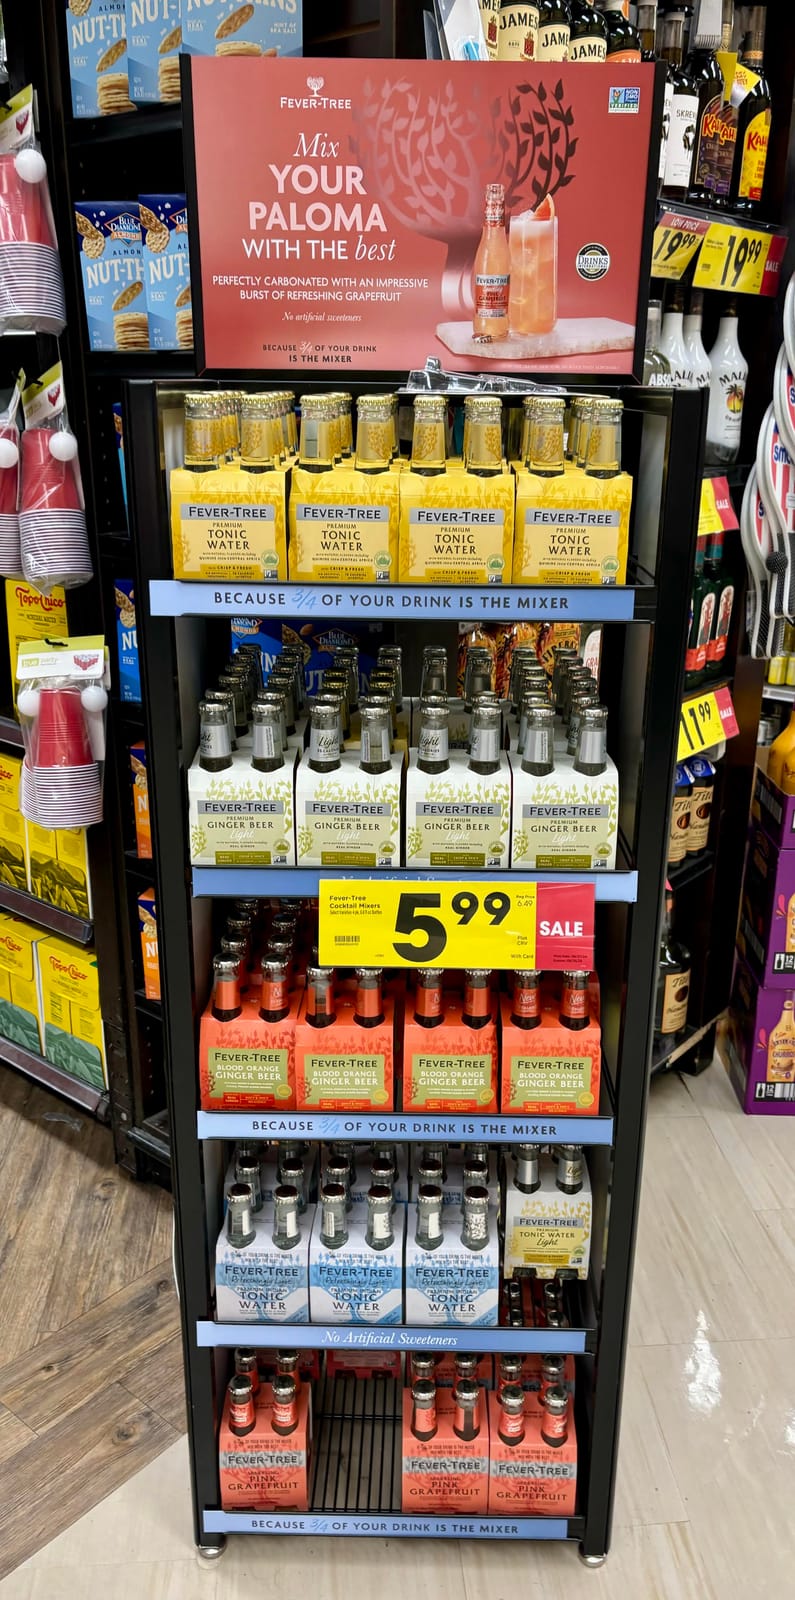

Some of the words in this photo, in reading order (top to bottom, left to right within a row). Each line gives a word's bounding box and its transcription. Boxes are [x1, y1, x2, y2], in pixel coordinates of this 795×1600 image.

[280, 96, 352, 109] FEVER-TREE
[293, 133, 339, 158] Mix
[268, 164, 367, 195] YOUR
[248, 202, 388, 232] PALOMA
[242, 239, 300, 260] WITH
[306, 240, 348, 260] THE
[355, 234, 396, 261] best
[578, 255, 609, 265] DRINKS
[212, 276, 261, 286] PERFECTLY
[264, 277, 328, 287] CARBONATED
[331, 278, 357, 287] WITH
[360, 278, 374, 287] AN
[376, 278, 429, 288] IMPRESSIVE
[240, 291, 269, 300] BURST
[271, 291, 285, 300] OF
[287, 291, 343, 301] REFRESHING
[346, 292, 401, 302] GRAPEFRUIT
[282, 312, 294, 321] No
[296, 312, 325, 323] artificial
[327, 313, 362, 322] sweeteners
[263, 344, 297, 352] BECAUSE
[315, 344, 326, 352] OF
[328, 344, 350, 353] YOUR
[353, 345, 377, 353] DRINK
[323, 355, 352, 363] MIXER
[189, 506, 267, 518] FEVER-TREE
[303, 507, 381, 520] FEVER-TREE
[418, 510, 495, 523] FEVER-TREE
[534, 511, 612, 524] FEVER-TREE
[207, 529, 247, 539] TONIC
[321, 531, 361, 541] TONIC
[435, 534, 474, 544] TONIC
[207, 540, 250, 550] WATER
[550, 535, 590, 545] TONIC
[320, 541, 363, 551] WATER
[434, 545, 476, 555] WATER
[548, 546, 591, 556] WATER
[214, 592, 286, 605] BECAUSE
[321, 594, 343, 606] OF
[350, 595, 395, 607] YOUR
[402, 595, 451, 608] DRINK
[459, 597, 473, 608] IS
[480, 597, 510, 609] THE
[517, 597, 569, 609] MIXER
[205, 802, 277, 813] FEVER-TREE
[313, 804, 384, 815] FEVER-TREE
[423, 804, 494, 815] FEVER-TREE
[529, 806, 601, 816] FEVER-TREE
[207, 821, 246, 830] GINGER
[248, 821, 274, 829] BEER
[314, 822, 354, 831] GINGER
[356, 823, 381, 831] BEER
[424, 822, 464, 831] GINGER
[466, 822, 490, 831] BEER
[530, 824, 570, 833] GINGER
[573, 825, 597, 833] BEER
[329, 902, 357, 910] Cocktail
[540, 921, 583, 936] SALE
[215, 1052, 281, 1063] FEVER-TREE
[217, 1064, 245, 1072] BLOOD
[246, 1065, 279, 1073] ORANGE
[311, 1059, 378, 1069] FEVER-TREE
[419, 1059, 485, 1069] FEVER-TREE
[518, 1060, 584, 1070] FEVER-TREE
[216, 1072, 254, 1080] GINGER
[257, 1072, 282, 1081] BEER
[311, 1077, 350, 1086] GINGER
[354, 1077, 378, 1086] BEER
[419, 1078, 458, 1086] GINGER
[461, 1078, 486, 1086] BEER
[517, 1080, 557, 1088] GINGER
[560, 1080, 584, 1089] BEER
[252, 1121, 314, 1131] BECAUSE
[344, 1122, 362, 1132] OF
[368, 1122, 408, 1133] YOUR
[413, 1123, 456, 1134] DRINK
[463, 1124, 475, 1134] IS
[481, 1125, 507, 1134] THE
[512, 1125, 557, 1136] MIXER
[519, 1218, 578, 1227] FEVER-TREE
[536, 1238, 559, 1247] Light
[225, 1265, 299, 1277] FEVER-TREE
[319, 1266, 392, 1278] FEVER-TREE
[415, 1268, 489, 1278] FEVER-TREE
[239, 1292, 283, 1301] TONIC
[430, 1295, 473, 1303] TONIC
[239, 1302, 286, 1310] WATER
[428, 1303, 476, 1312] WATER
[322, 1331, 340, 1342] No
[343, 1331, 395, 1345] Artificial
[398, 1332, 458, 1346] Sweeteners
[228, 1455, 297, 1465] FEVER-TREE
[411, 1461, 480, 1470] FEVER-TREE
[499, 1465, 569, 1476] FEVER-TREE
[228, 1482, 299, 1491] GRAPEFRUIT
[431, 1480, 457, 1488] PINK
[409, 1488, 480, 1496] GRAPEFRUIT
[251, 1520, 305, 1529] BECAUSE
[331, 1522, 348, 1530] OF
[353, 1522, 388, 1531] YOUR
[392, 1523, 430, 1532] DRINK
[436, 1524, 446, 1532] IS
[451, 1524, 475, 1533] THE
[479, 1525, 519, 1534] MIXER
